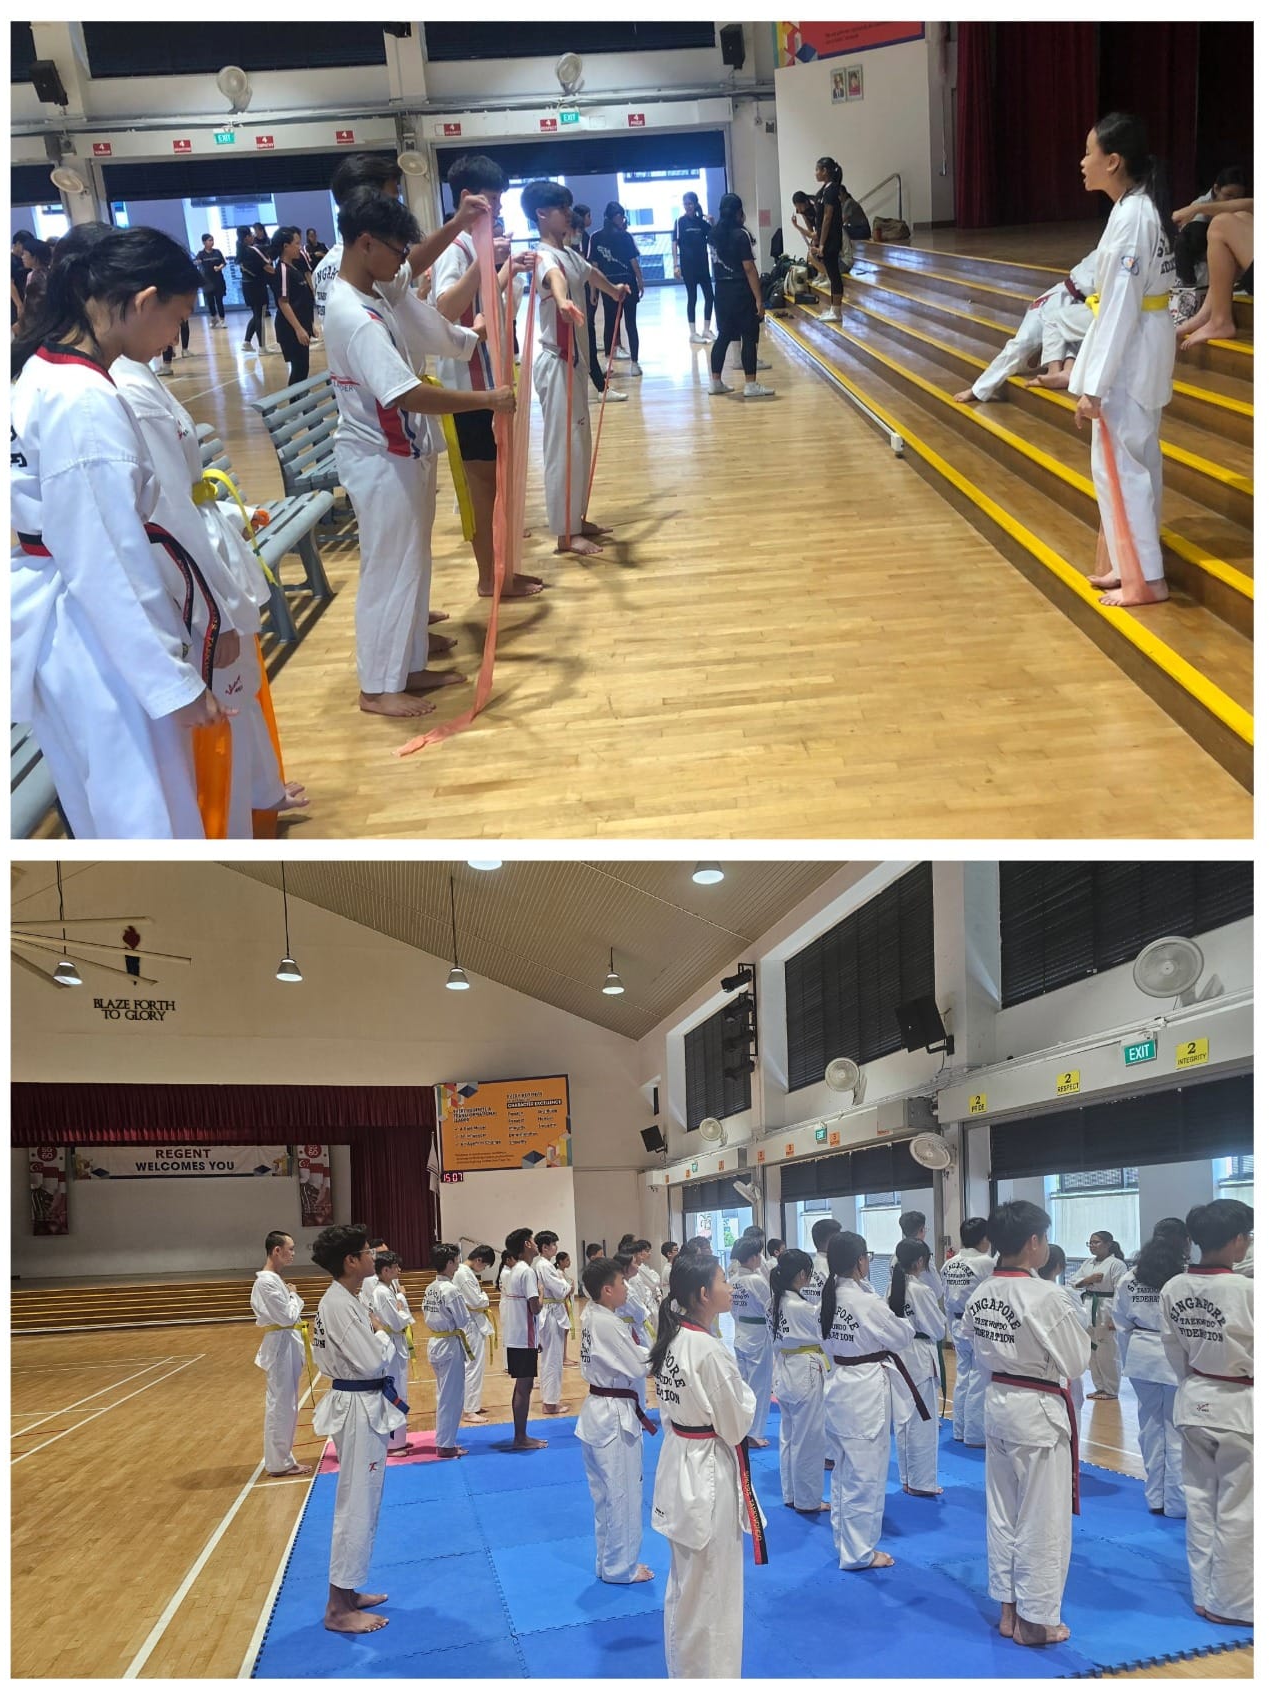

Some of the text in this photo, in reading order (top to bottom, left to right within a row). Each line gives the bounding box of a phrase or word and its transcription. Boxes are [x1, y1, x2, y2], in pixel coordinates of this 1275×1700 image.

[564, 113, 576, 121] EXIT
[218, 133, 231, 142] EXIT
[93, 998, 176, 1011] BLAZE FORTH
[102, 1009, 166, 1021] TO GLORY
[1128, 1043, 1149, 1061] EXIT
[1187, 1042, 1196, 1054] 2
[1177, 1052, 1207, 1066] INTEGRITY
[1065, 1073, 1071, 1083] 2
[1057, 1082, 1079, 1093] RESPECT
[975, 1095, 981, 1104] 2
[155, 1148, 212, 1159] REGENT
[136, 1161, 234, 1172] WELCOMES YOU
[970, 1298, 1022, 1330] INGAPORE
